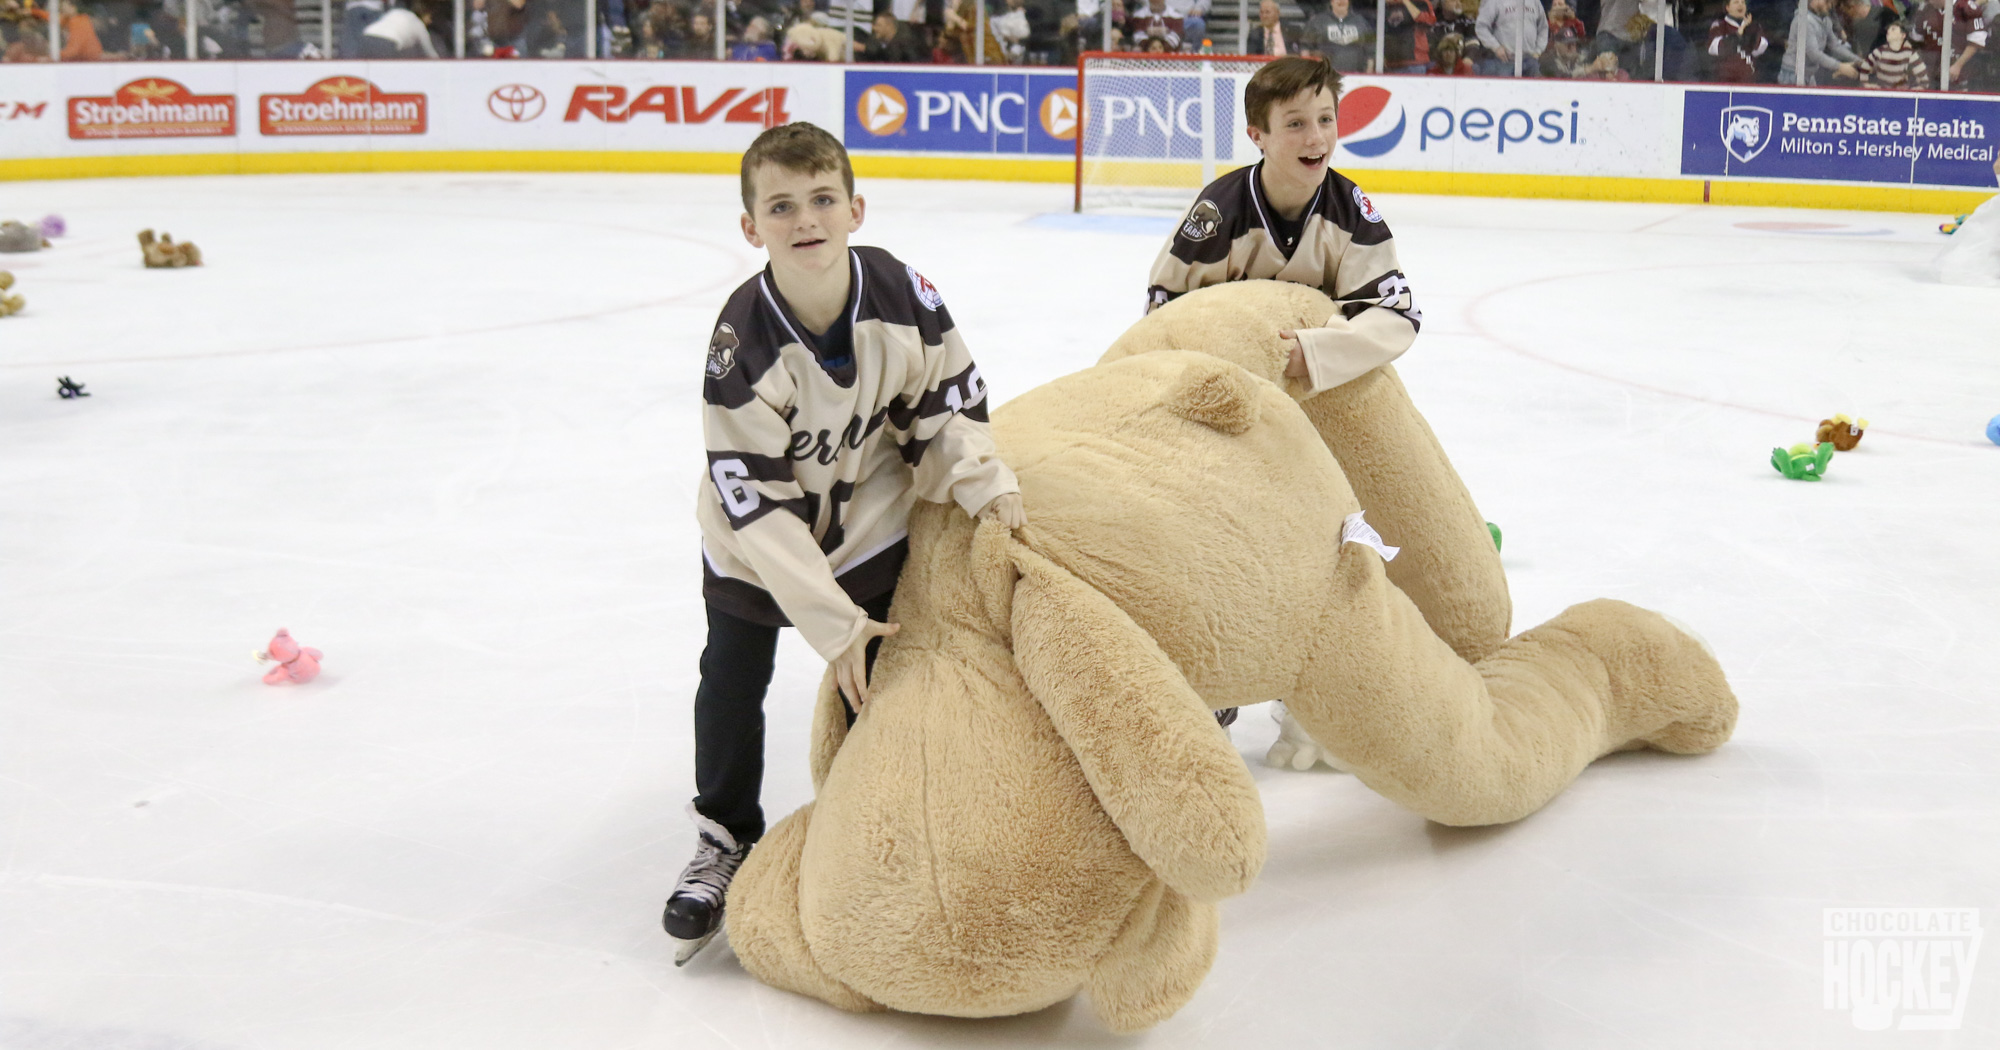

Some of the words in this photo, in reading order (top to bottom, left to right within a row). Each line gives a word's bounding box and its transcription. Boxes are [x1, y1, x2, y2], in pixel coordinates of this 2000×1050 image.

[76, 100, 230, 125] Stroehmann
[268, 97, 418, 121] Stroehmann
[563, 85, 791, 129] RAV4
[914, 90, 1026, 134] PNC
[1420, 100, 1579, 154] pepsi
[1782, 112, 1901, 136] PennState
[1906, 116, 1986, 139] Health
[1781, 137, 1833, 155] Milton
[1837, 139, 1852, 156] S.
[1855, 140, 1923, 162] Hershey
[1927, 143, 1993, 162] Medical
[711, 458, 761, 518] 6
